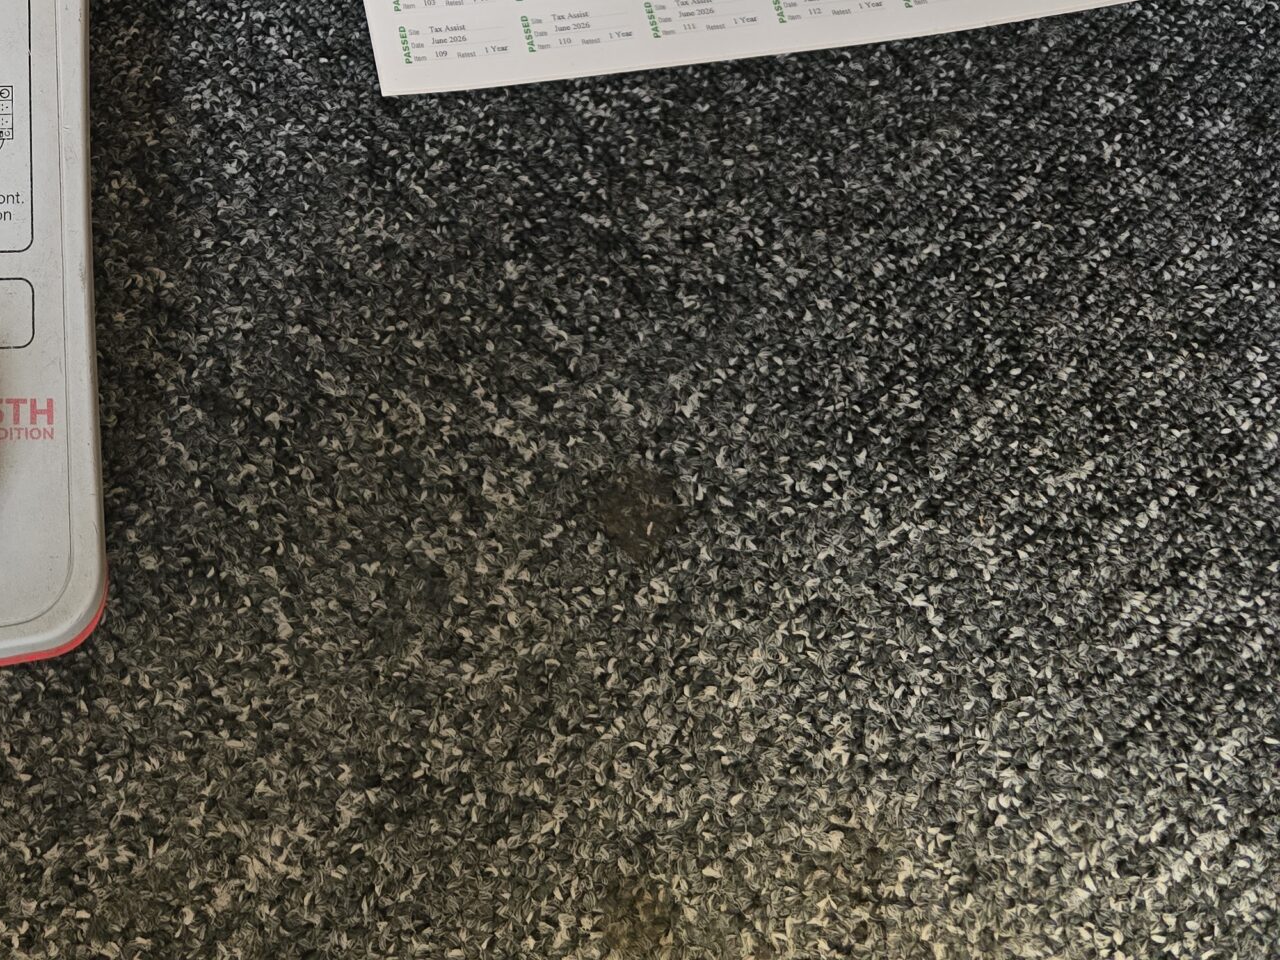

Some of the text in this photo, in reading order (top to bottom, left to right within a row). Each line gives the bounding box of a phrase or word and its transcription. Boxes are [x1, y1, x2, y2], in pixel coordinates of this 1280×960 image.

[429, 25, 442, 33] Tax
[444, 24, 466, 32] Assist
[431, 37, 447, 45] June
[448, 35, 467, 43] 2026
[399, 26, 413, 64] PASSED
[435, 50, 448, 58] 109
